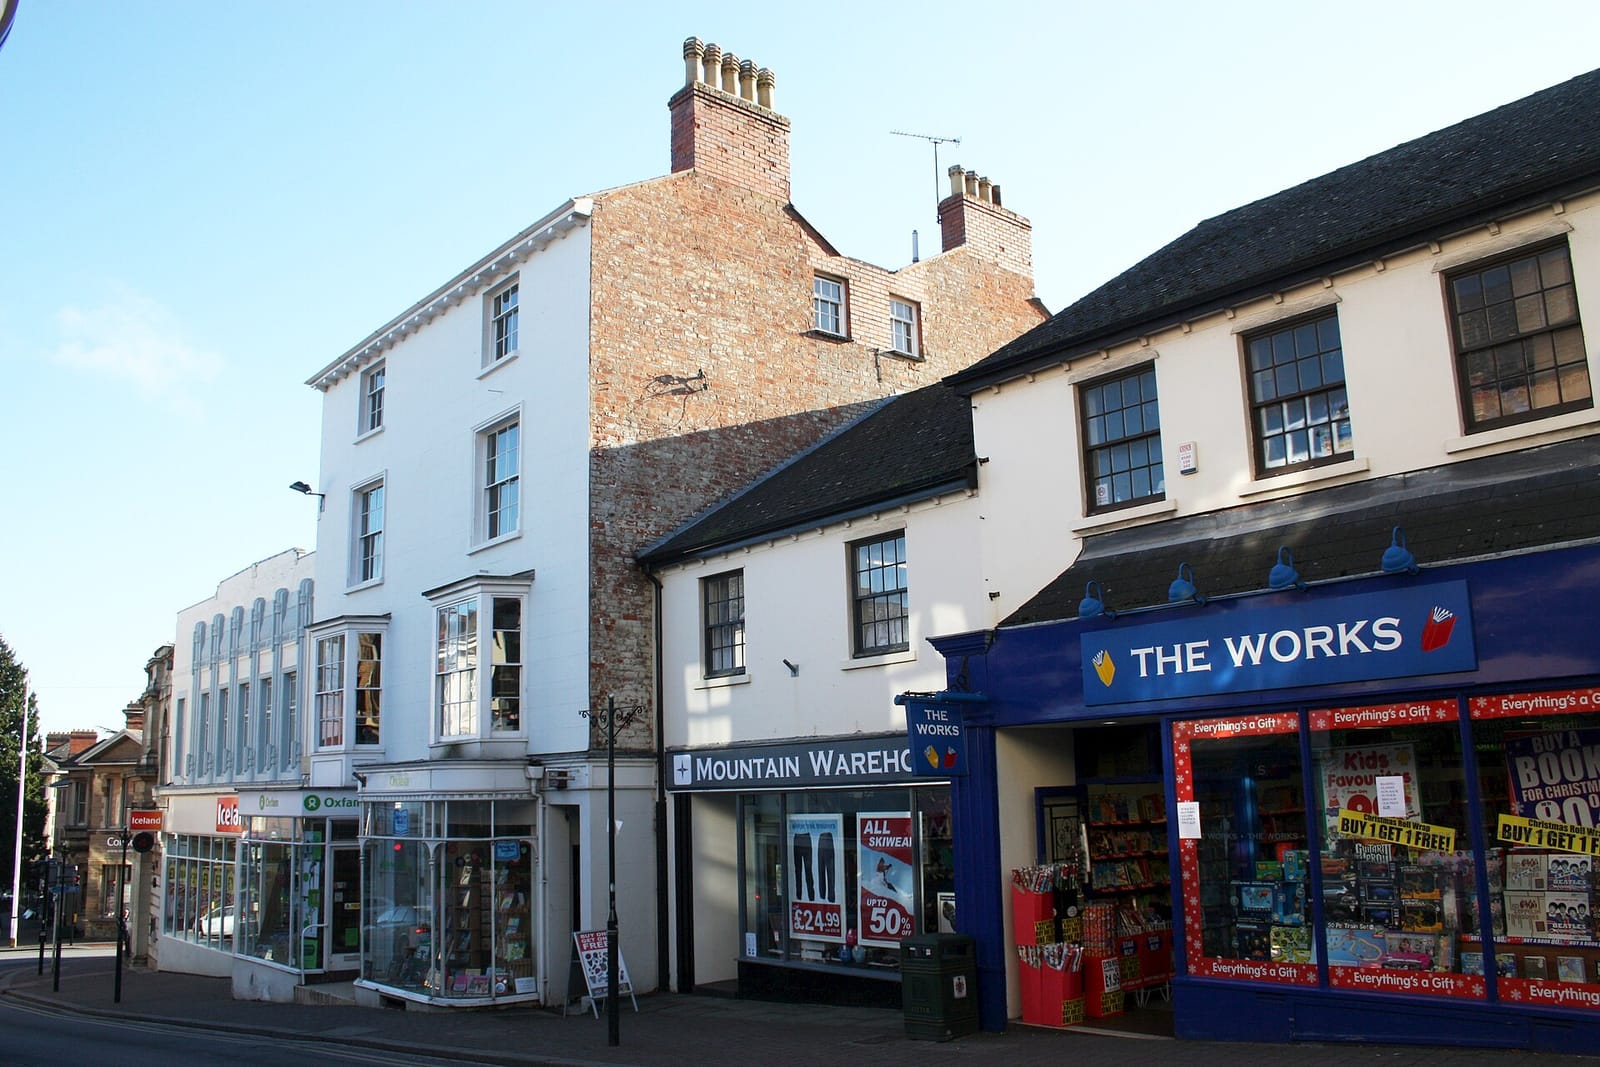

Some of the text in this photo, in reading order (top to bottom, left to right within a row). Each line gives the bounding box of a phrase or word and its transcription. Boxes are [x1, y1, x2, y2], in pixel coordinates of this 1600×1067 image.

[1130, 617, 1403, 678] THE WORKS
[1501, 694, 1576, 711] Everything's
[1579, 695, 1589, 705] a
[924, 709, 948, 721] THE
[1334, 705, 1431, 724] Everything's a Gift
[916, 723, 960, 738] WORKS
[1194, 720, 1247, 734] Everything's
[1257, 717, 1276, 728] Gift
[1531, 731, 1582, 753] BUY A
[697, 755, 800, 781] MOUNTAIN
[1343, 750, 1389, 771] Kids
[1521, 788, 1544, 802] FOR
[132, 816, 161, 825] Iceland
[863, 820, 891, 835] ALL
[1363, 813, 1398, 826] Christmas
[1412, 821, 1431, 832] Wrap
[1528, 818, 1569, 832] Christmas
[1340, 817, 1451, 852] BUY 1 GET 1 FREE!
[1502, 823, 1533, 843] BUY
[1535, 829, 1544, 845] 1
[1547, 830, 1576, 850] GET
[1579, 836, 1587, 852] 1
[793, 908, 840, 932] £24.99
[1212, 962, 1268, 978] Everything's
[1278, 967, 1298, 978] Gift
[1353, 972, 1455, 990] Everything's a Gift
